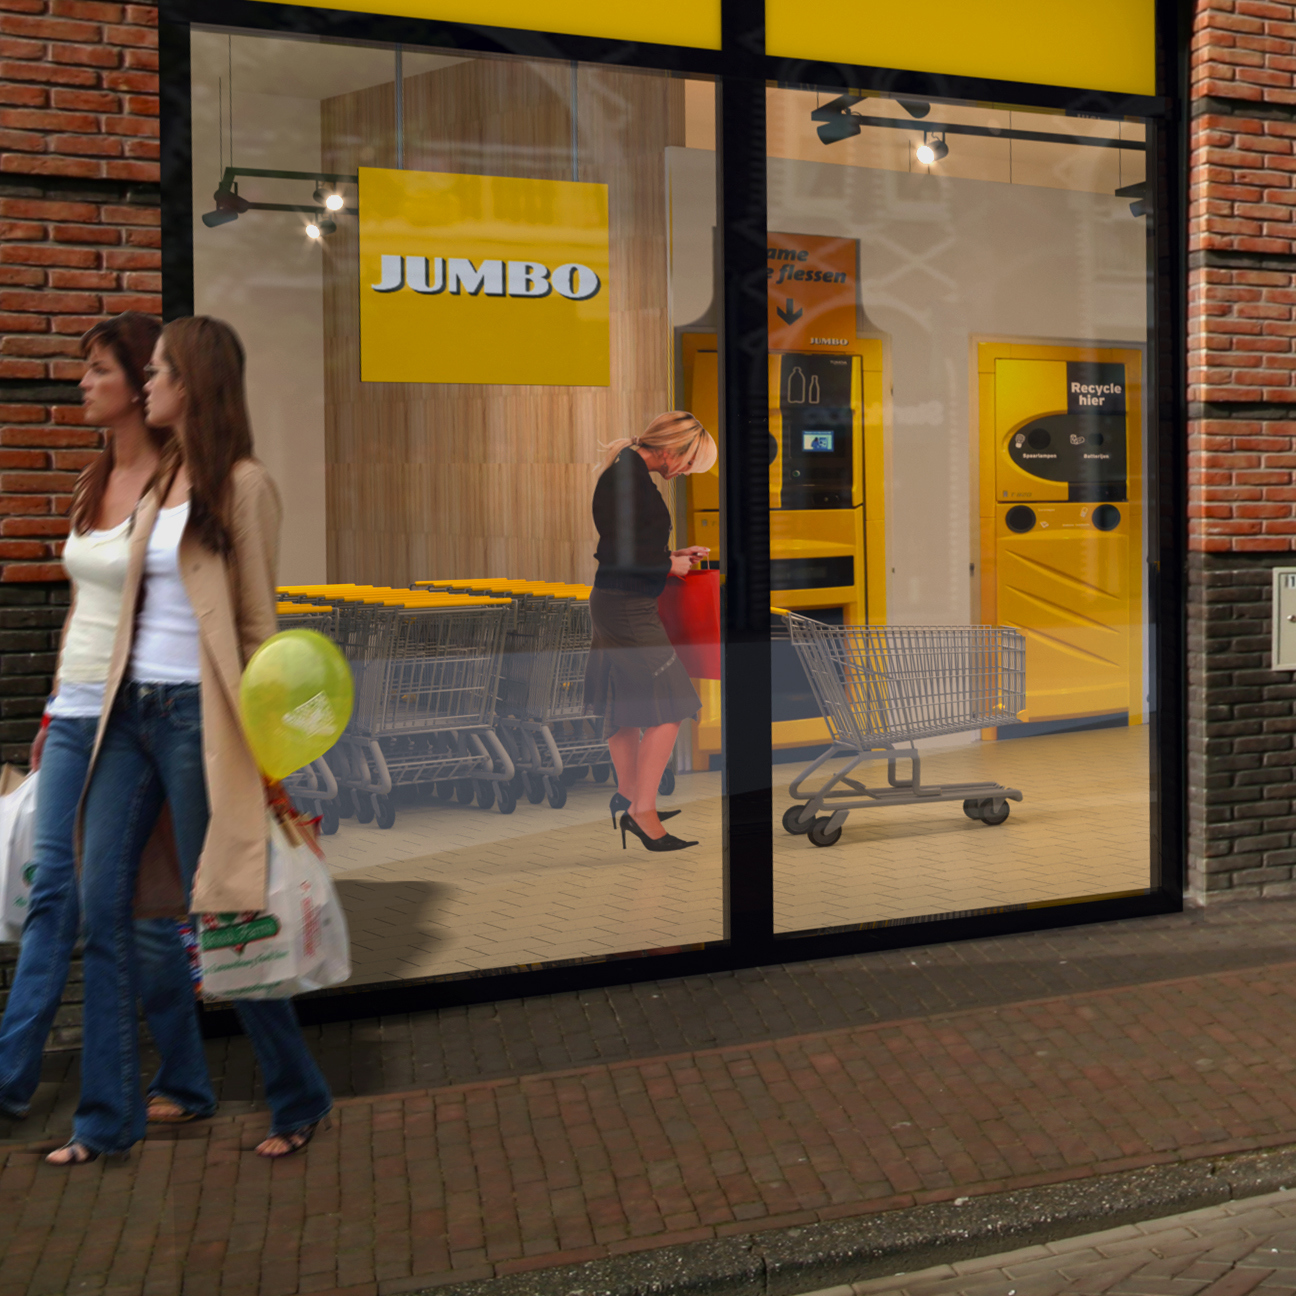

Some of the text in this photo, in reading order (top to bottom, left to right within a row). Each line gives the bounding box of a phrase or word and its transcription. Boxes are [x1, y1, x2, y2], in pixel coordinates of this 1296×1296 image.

[371, 254, 602, 301] JUMBO
[776, 264, 847, 284] flessen
[810, 337, 849, 346] JUMBO
[1071, 382, 1122, 396] Recycle
[1079, 394, 1105, 406] hier
